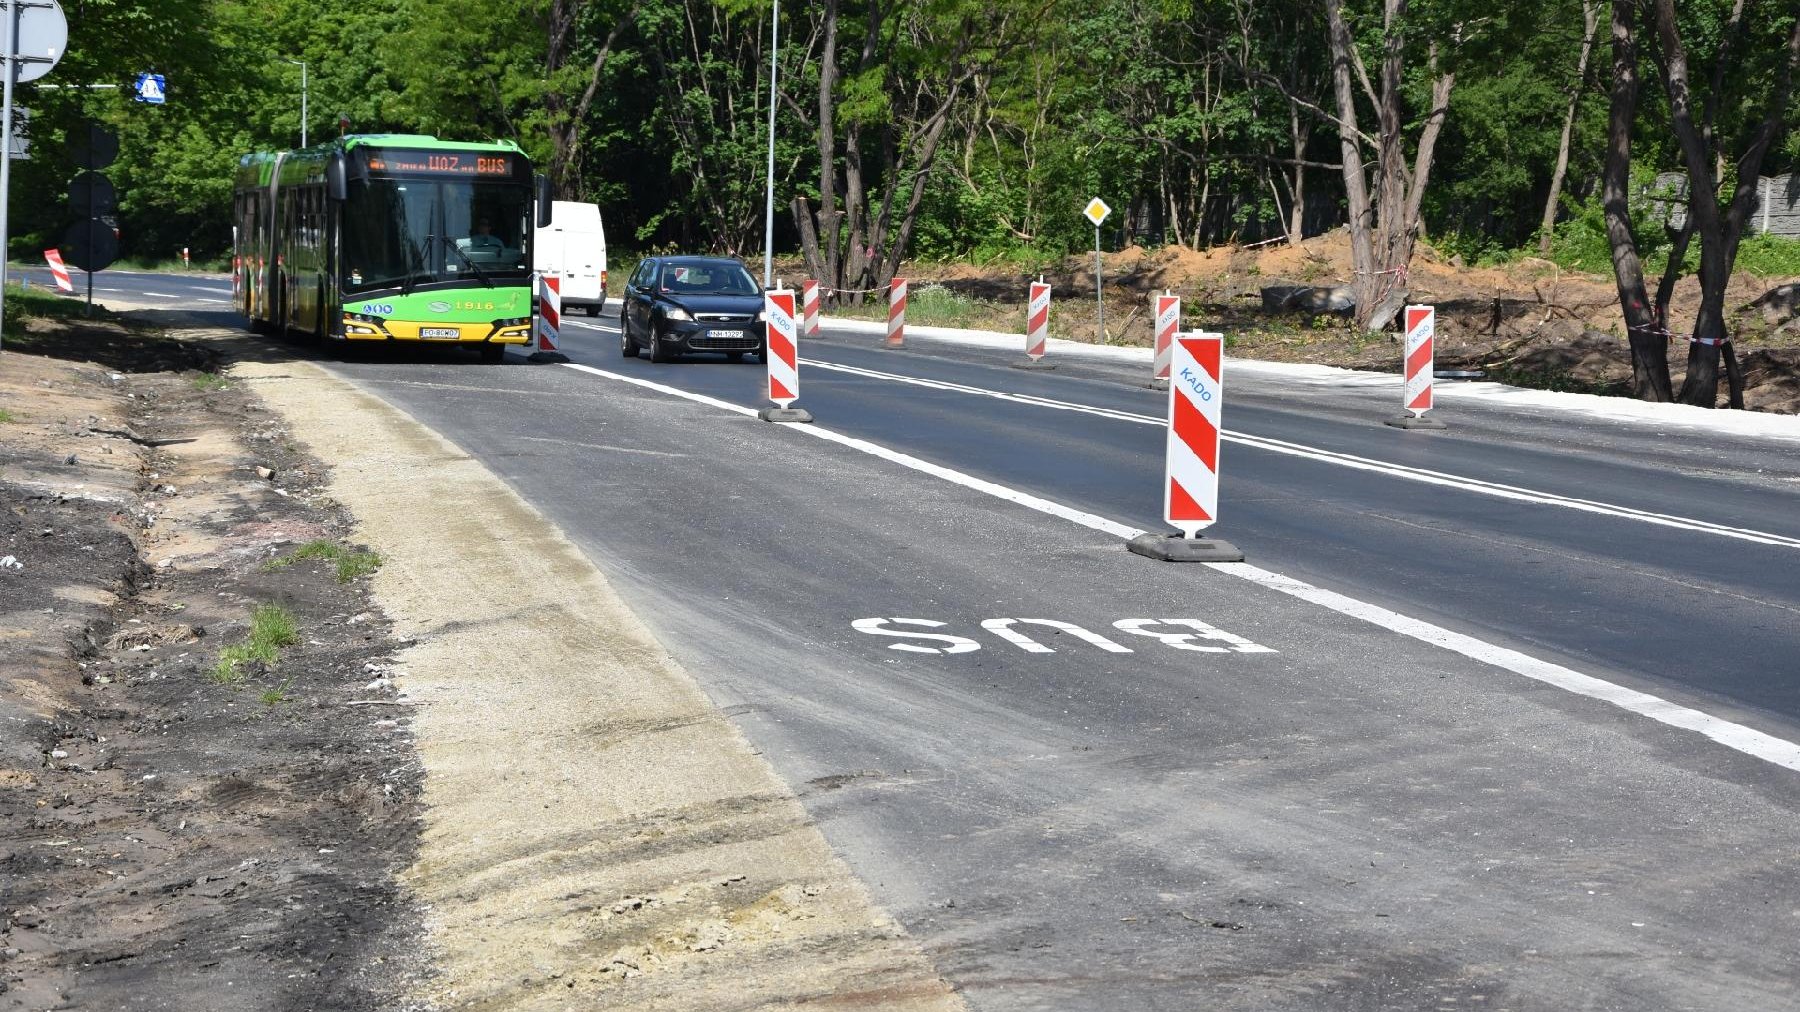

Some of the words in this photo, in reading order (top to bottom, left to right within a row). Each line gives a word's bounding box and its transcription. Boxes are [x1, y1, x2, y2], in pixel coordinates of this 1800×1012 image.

[477, 158, 505, 173] BUS
[455, 302, 494, 310] 1916
[771, 311, 791, 330] KADO
[1411, 325, 1430, 343] KADO
[1180, 366, 1212, 402] KADO
[851, 617, 1280, 654] BUS
